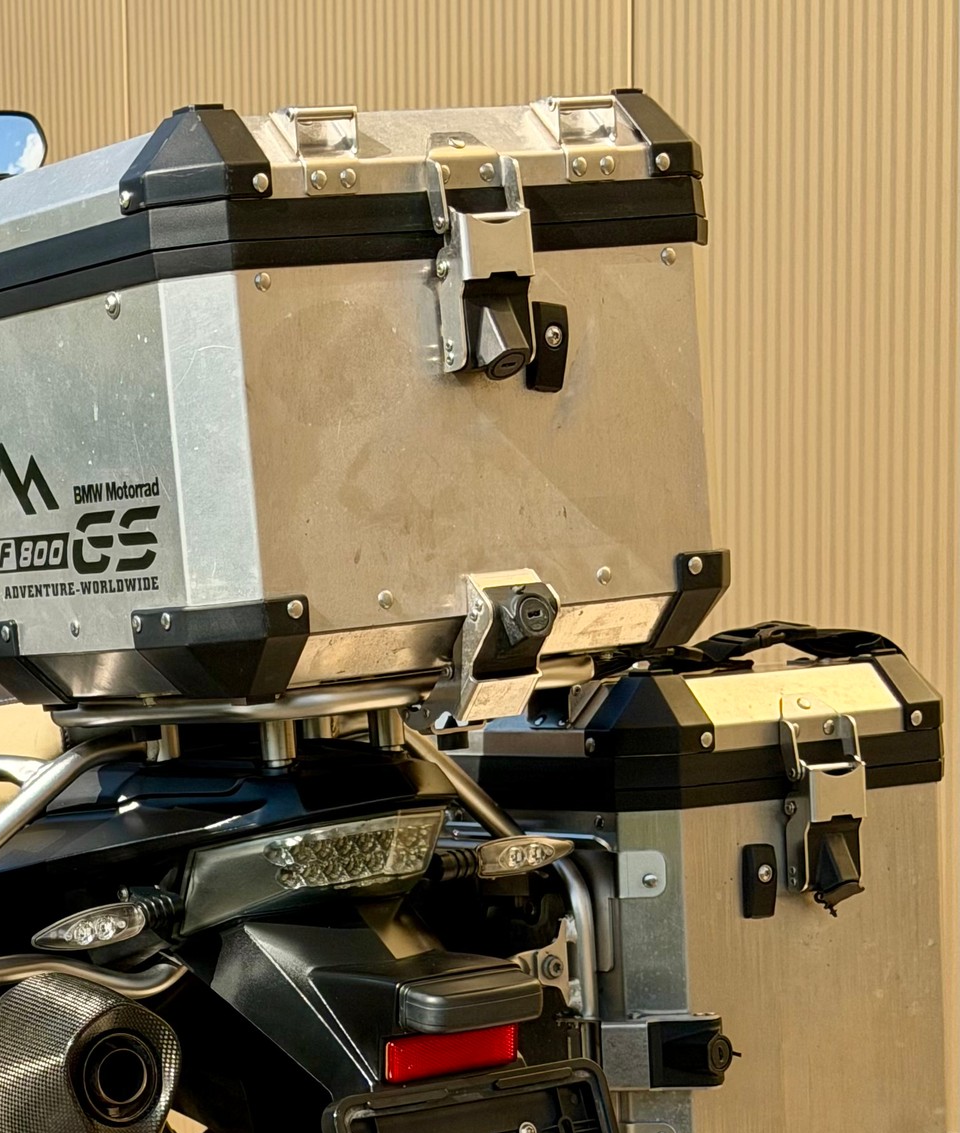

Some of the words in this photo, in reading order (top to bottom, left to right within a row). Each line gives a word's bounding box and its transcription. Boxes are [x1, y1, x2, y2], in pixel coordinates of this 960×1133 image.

[73, 483, 103, 504] BMW
[106, 476, 160, 500] Motorrad
[0, 542, 12, 568] F
[19, 539, 65, 568] 800
[72, 505, 161, 574] GS
[4, 576, 160, 600] ADVENTURE-WORLDWIDE
